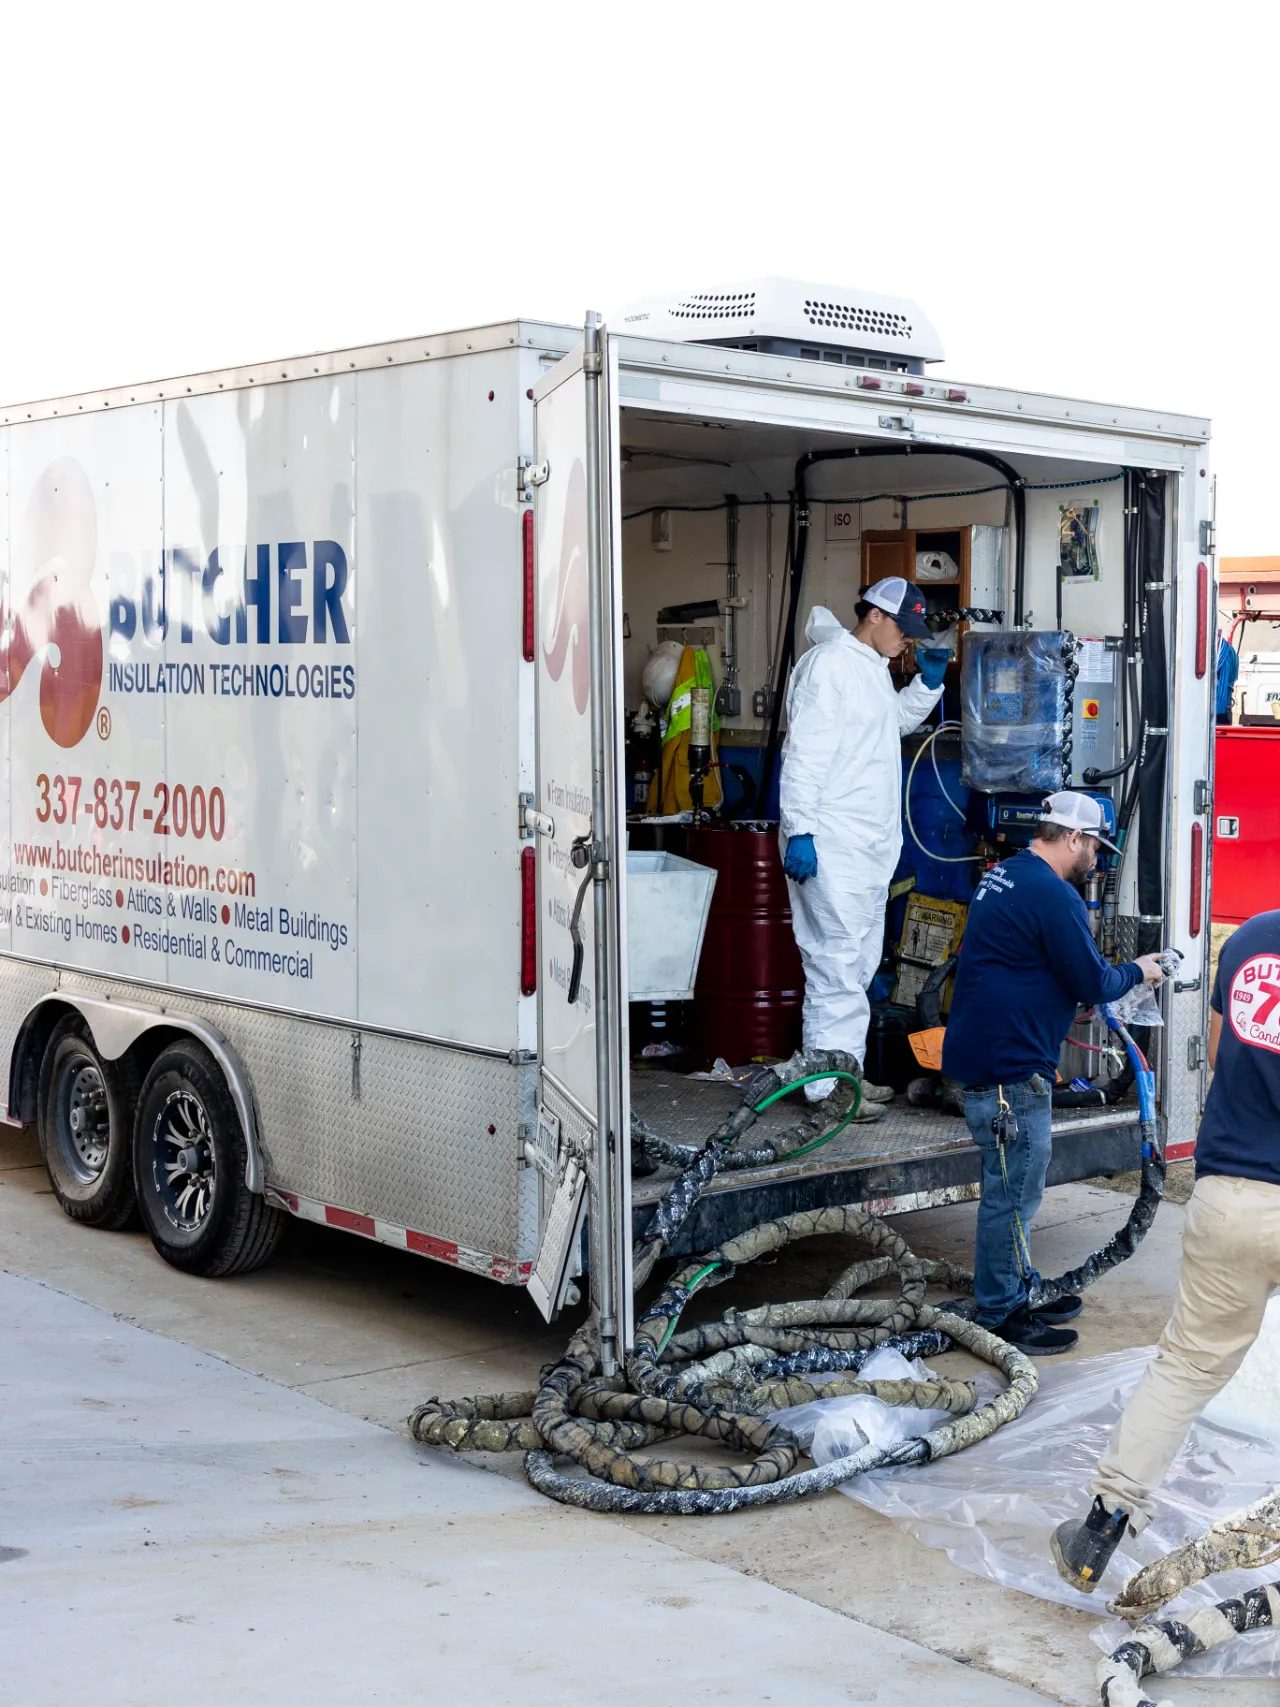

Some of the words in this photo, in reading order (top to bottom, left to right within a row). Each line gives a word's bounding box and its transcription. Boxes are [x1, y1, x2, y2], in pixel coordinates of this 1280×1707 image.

[834, 512, 852, 526] ISO
[109, 540, 350, 645] BUTCHER
[109, 663, 205, 695] INSULATION
[210, 663, 355, 699] TECHNOLOGIES
[36, 774, 225, 841] 337-837-2000
[14, 840, 256, 897] www.butcherinsulation.com
[0, 869, 35, 895] ulation
[51, 876, 113, 909] Fiberglass
[127, 887, 162, 915] Attics
[166, 892, 176, 917] &
[180, 893, 217, 924] Walls
[234, 902, 273, 932] Metal
[279, 908, 348, 951] Buildings
[921, 911, 953, 926] WARNING
[16, 904, 23, 927] &
[26, 906, 71, 941] Existing
[76, 914, 118, 944] Homes
[134, 924, 207, 960] Residential
[211, 936, 220, 962] &
[225, 939, 313, 979] Commercial
[1234, 990, 1252, 1002] 1949
